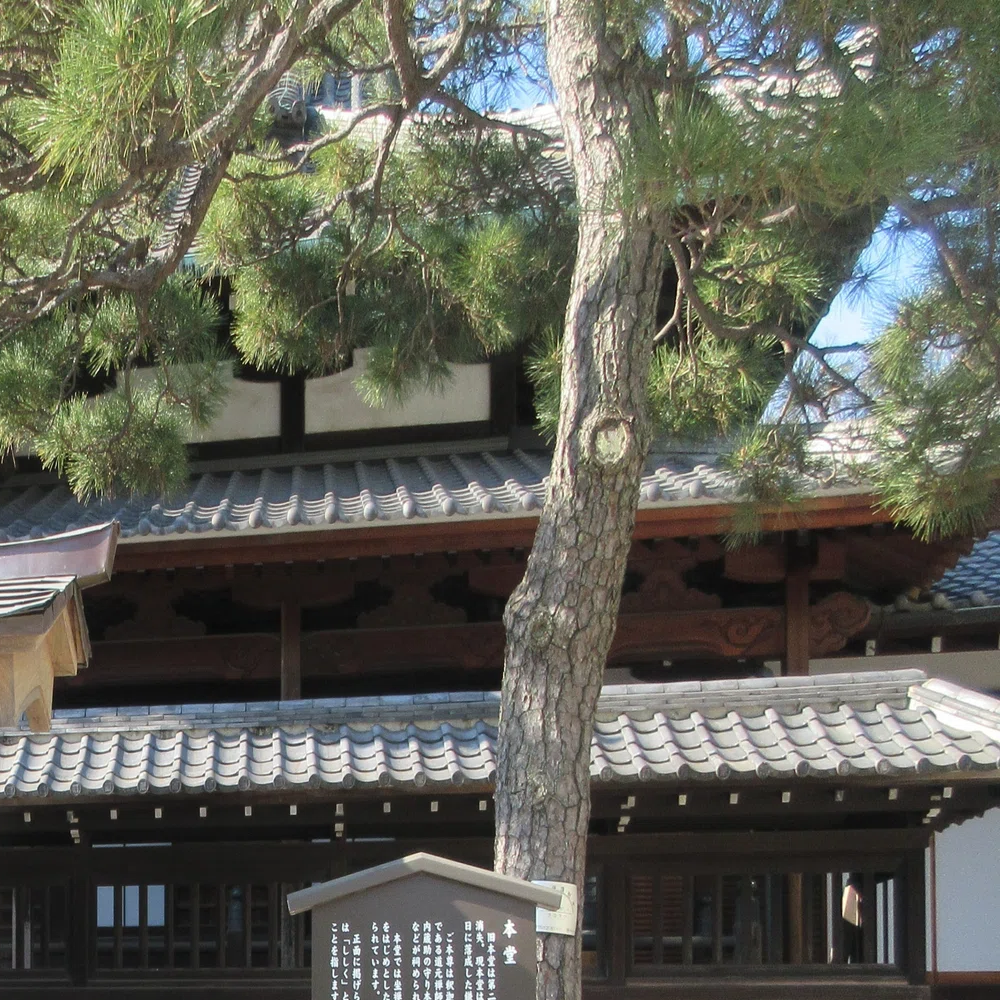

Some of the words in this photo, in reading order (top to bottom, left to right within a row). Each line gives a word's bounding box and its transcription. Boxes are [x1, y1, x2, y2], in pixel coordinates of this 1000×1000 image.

[371, 923, 380, 997] られています。
[503, 919, 516, 965] 本堂
